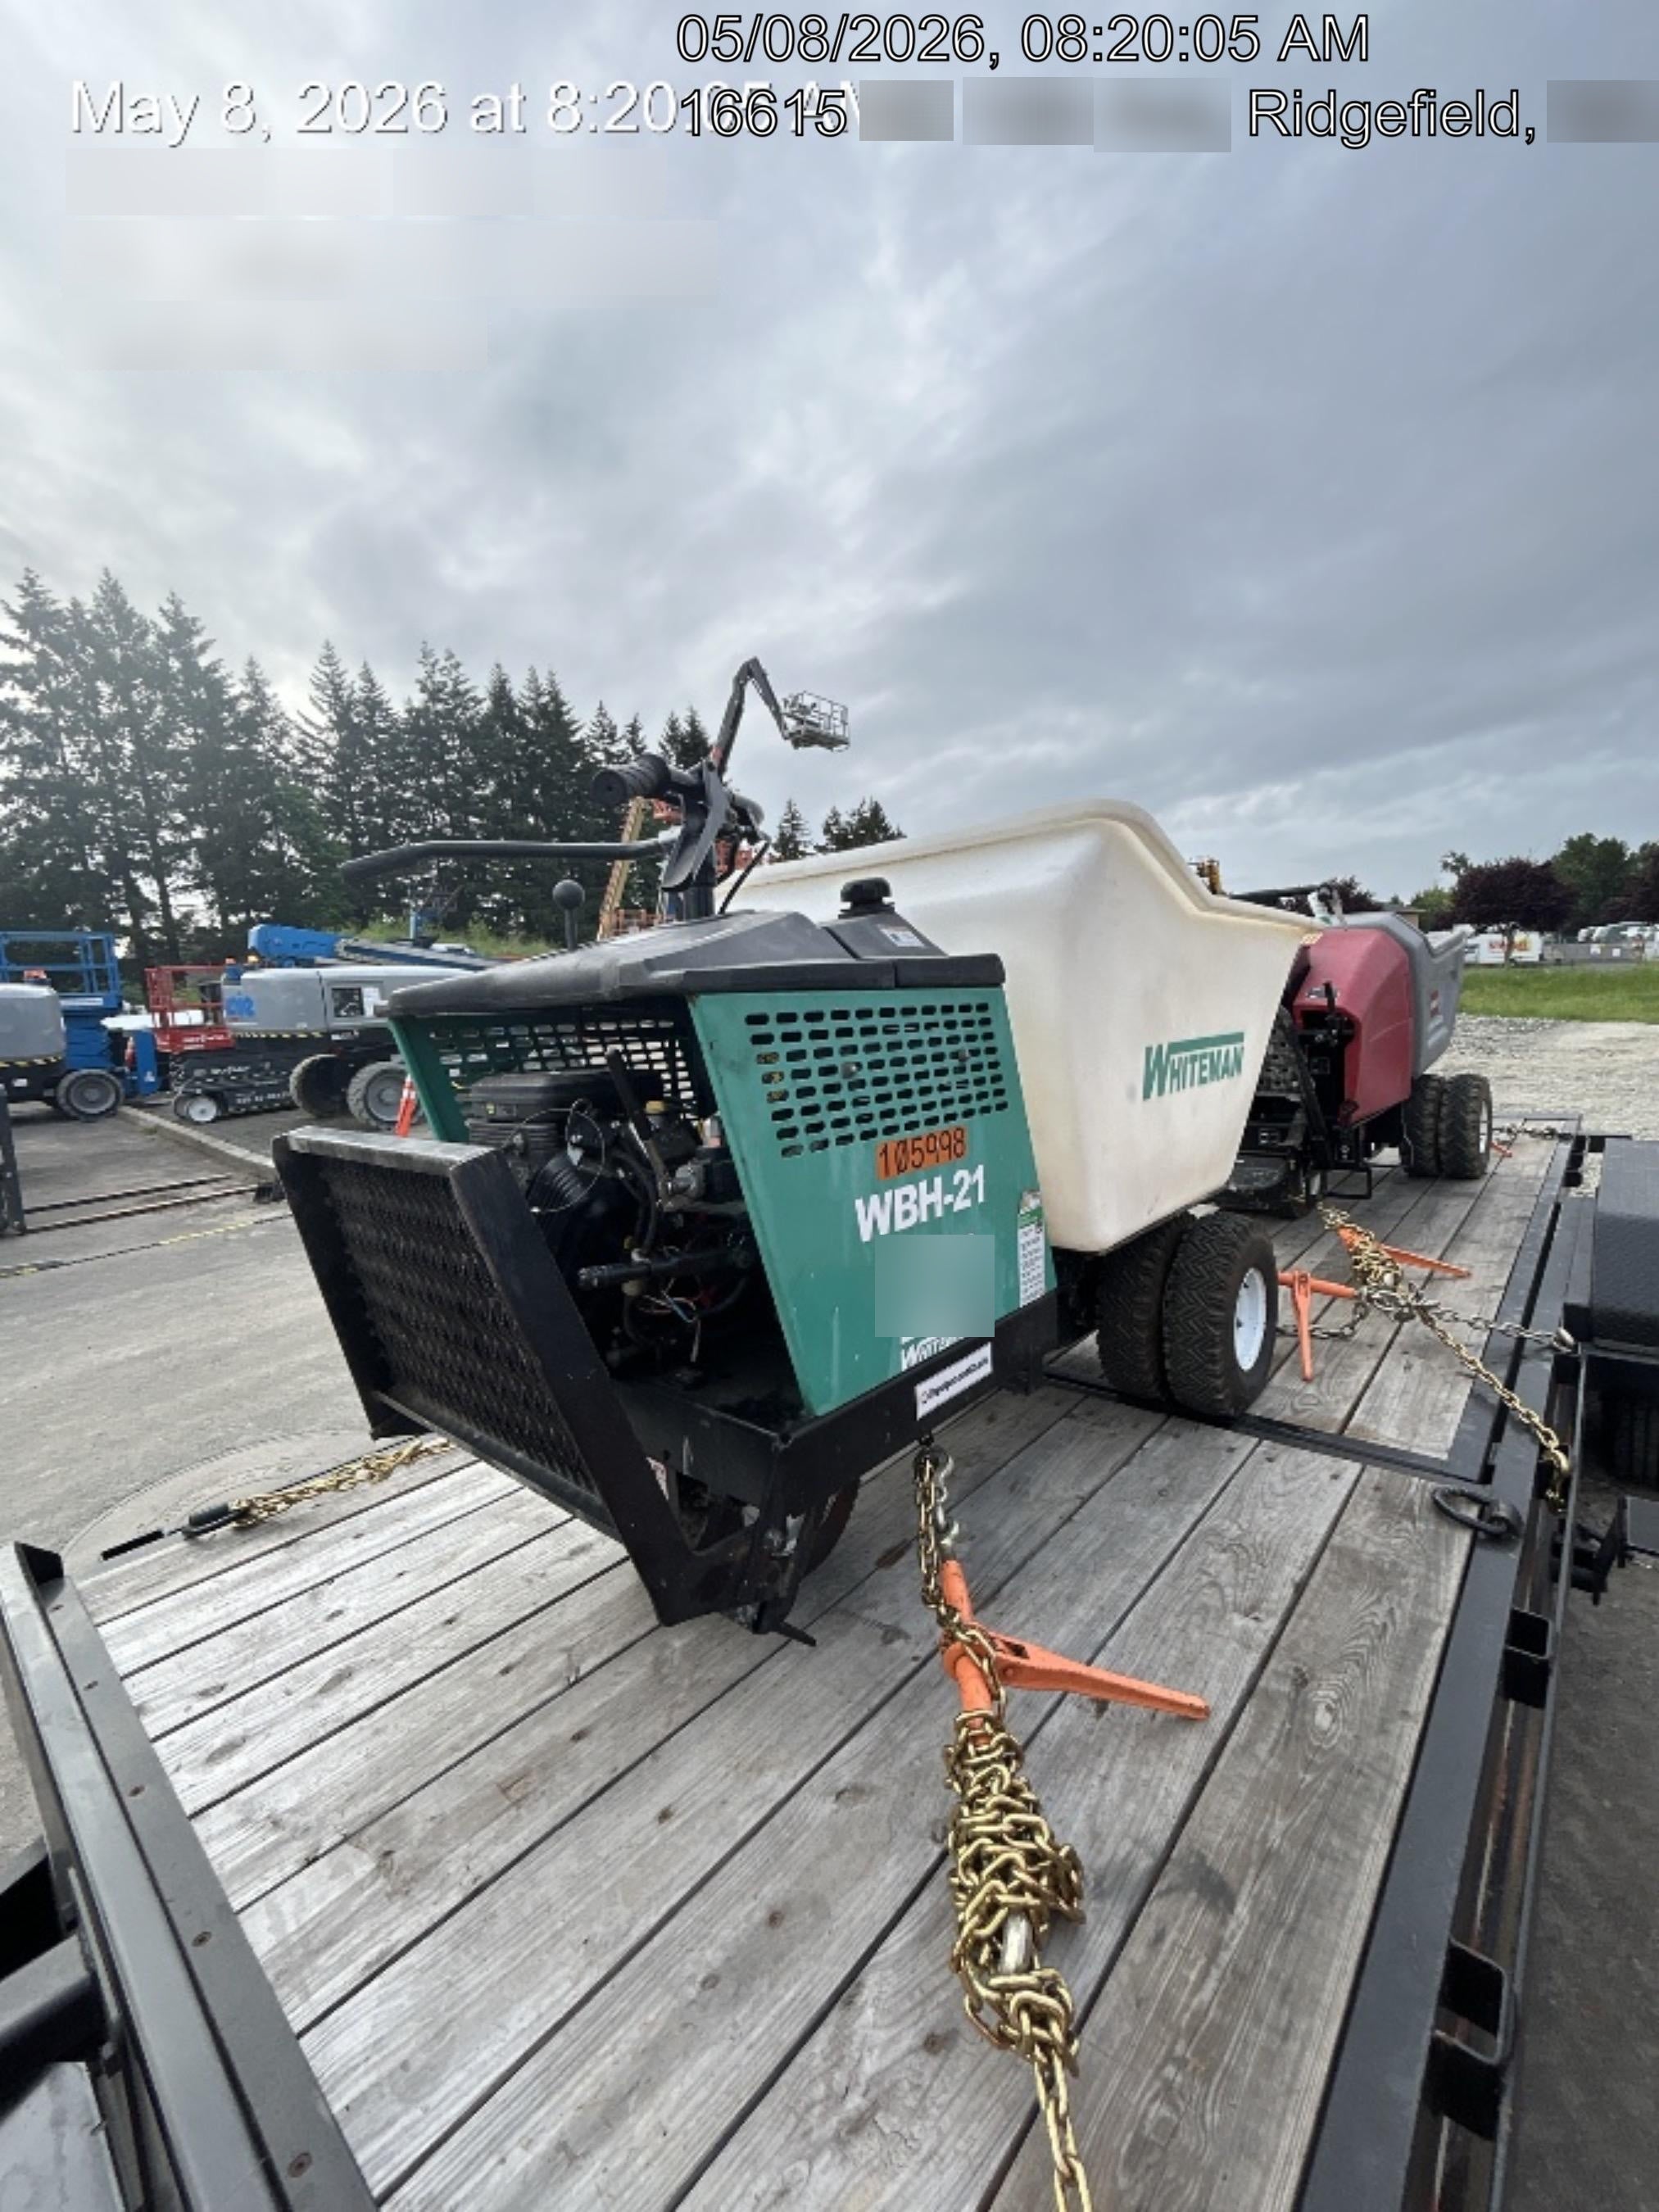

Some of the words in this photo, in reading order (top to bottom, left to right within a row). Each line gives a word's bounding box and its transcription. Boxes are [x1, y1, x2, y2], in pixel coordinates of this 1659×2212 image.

[1142, 1031, 1245, 1102] WHITEMAN
[878, 1126, 968, 1177] 105998
[854, 1163, 986, 1243] WBH-21
